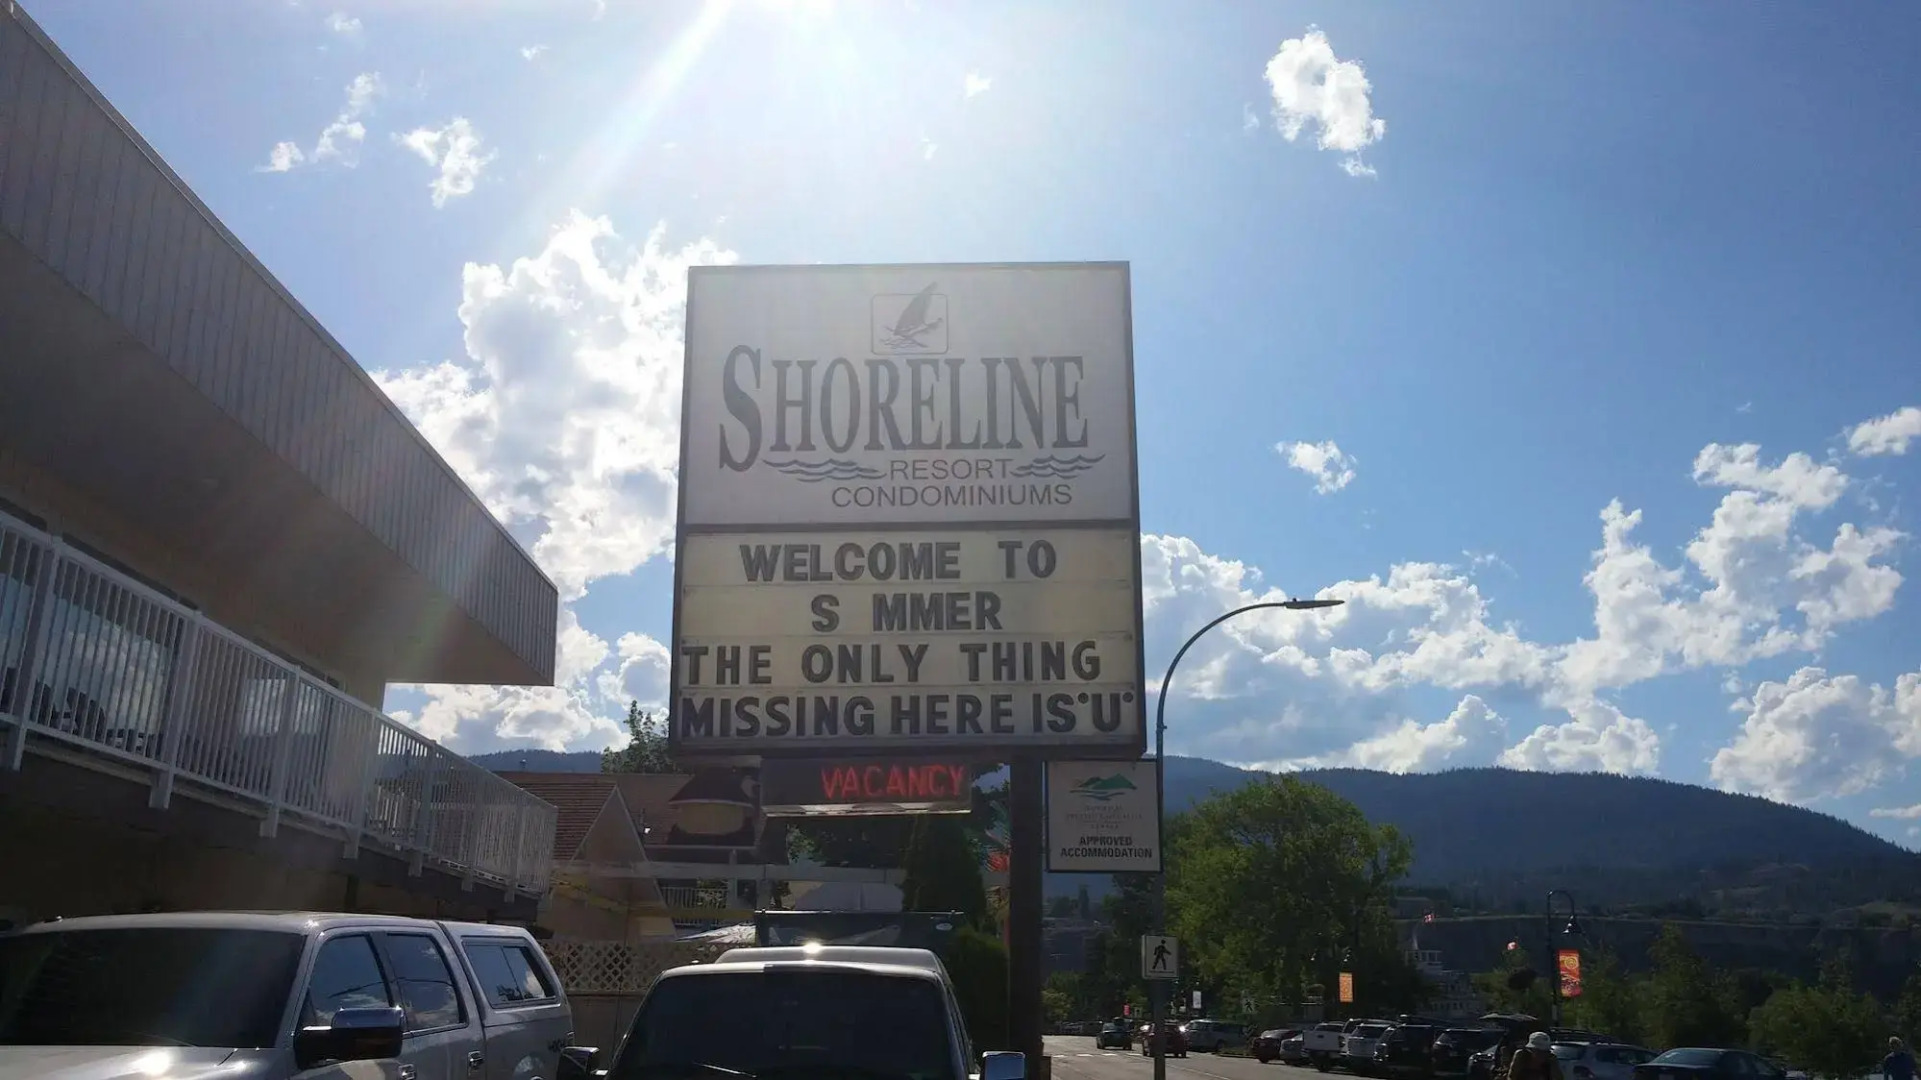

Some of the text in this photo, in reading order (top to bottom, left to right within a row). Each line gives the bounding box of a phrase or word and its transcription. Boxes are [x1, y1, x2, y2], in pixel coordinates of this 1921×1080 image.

[719, 344, 1088, 472] SHORELINE
[889, 458, 1014, 480] RESORT
[831, 484, 1073, 507] CONDOMINIUMS
[739, 539, 1057, 582] WELCOME TO
[682, 640, 1100, 685] THE ONLY THING
[681, 696, 874, 737] MISSING
[890, 694, 1015, 735] HERE
[821, 764, 965, 799] VACANCY
[1060, 847, 1153, 858] ACCOMMODATION
[1080, 836, 1133, 846] APPROVED
